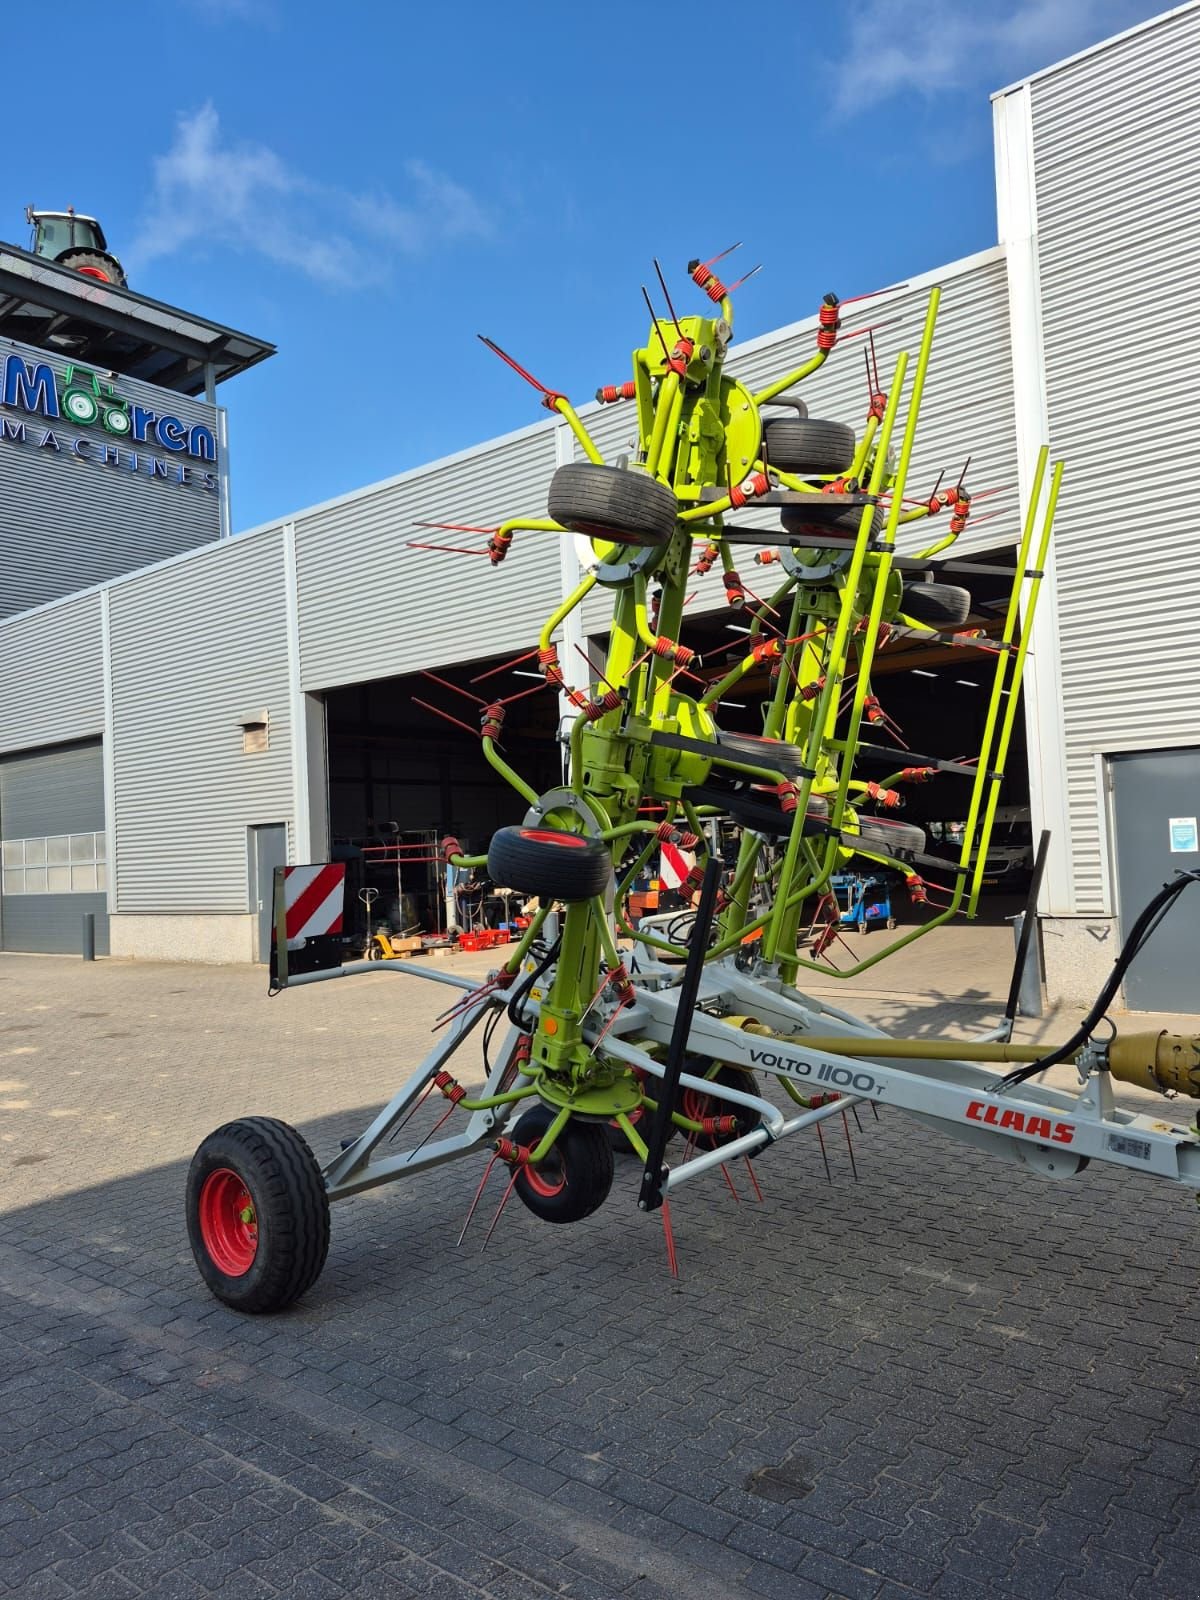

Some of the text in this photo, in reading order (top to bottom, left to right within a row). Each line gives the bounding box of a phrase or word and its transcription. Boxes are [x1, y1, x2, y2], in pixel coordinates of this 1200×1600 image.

[2, 354, 217, 461] Mooren
[1, 418, 216, 489] MACHINES
[749, 1048, 812, 1076] VOLTO
[965, 1101, 1076, 1144] CLAAS
